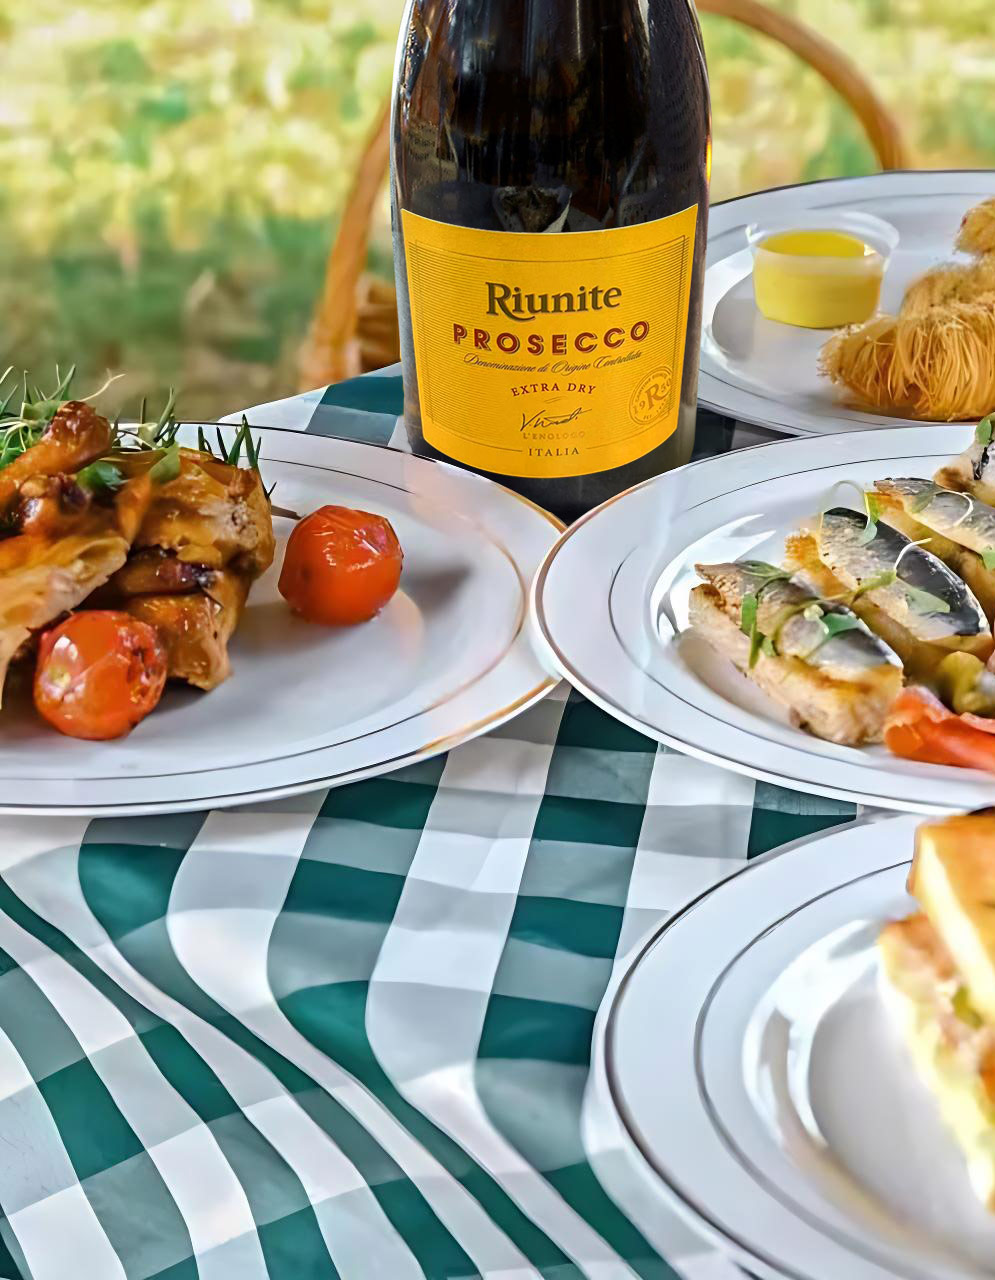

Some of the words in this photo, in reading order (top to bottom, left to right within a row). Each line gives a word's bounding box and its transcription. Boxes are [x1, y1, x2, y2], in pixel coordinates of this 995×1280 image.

[485, 281, 622, 321] Riunite
[453, 320, 650, 355] PROSECCO
[463, 352, 536, 372] Denominazione
[537, 363, 549, 372] di
[551, 360, 590, 376] Origine
[511, 382, 560, 397] EXTRA
[567, 382, 596, 394] DRY
[645, 383, 670, 410] R
[528, 447, 580, 457] ITALIA
